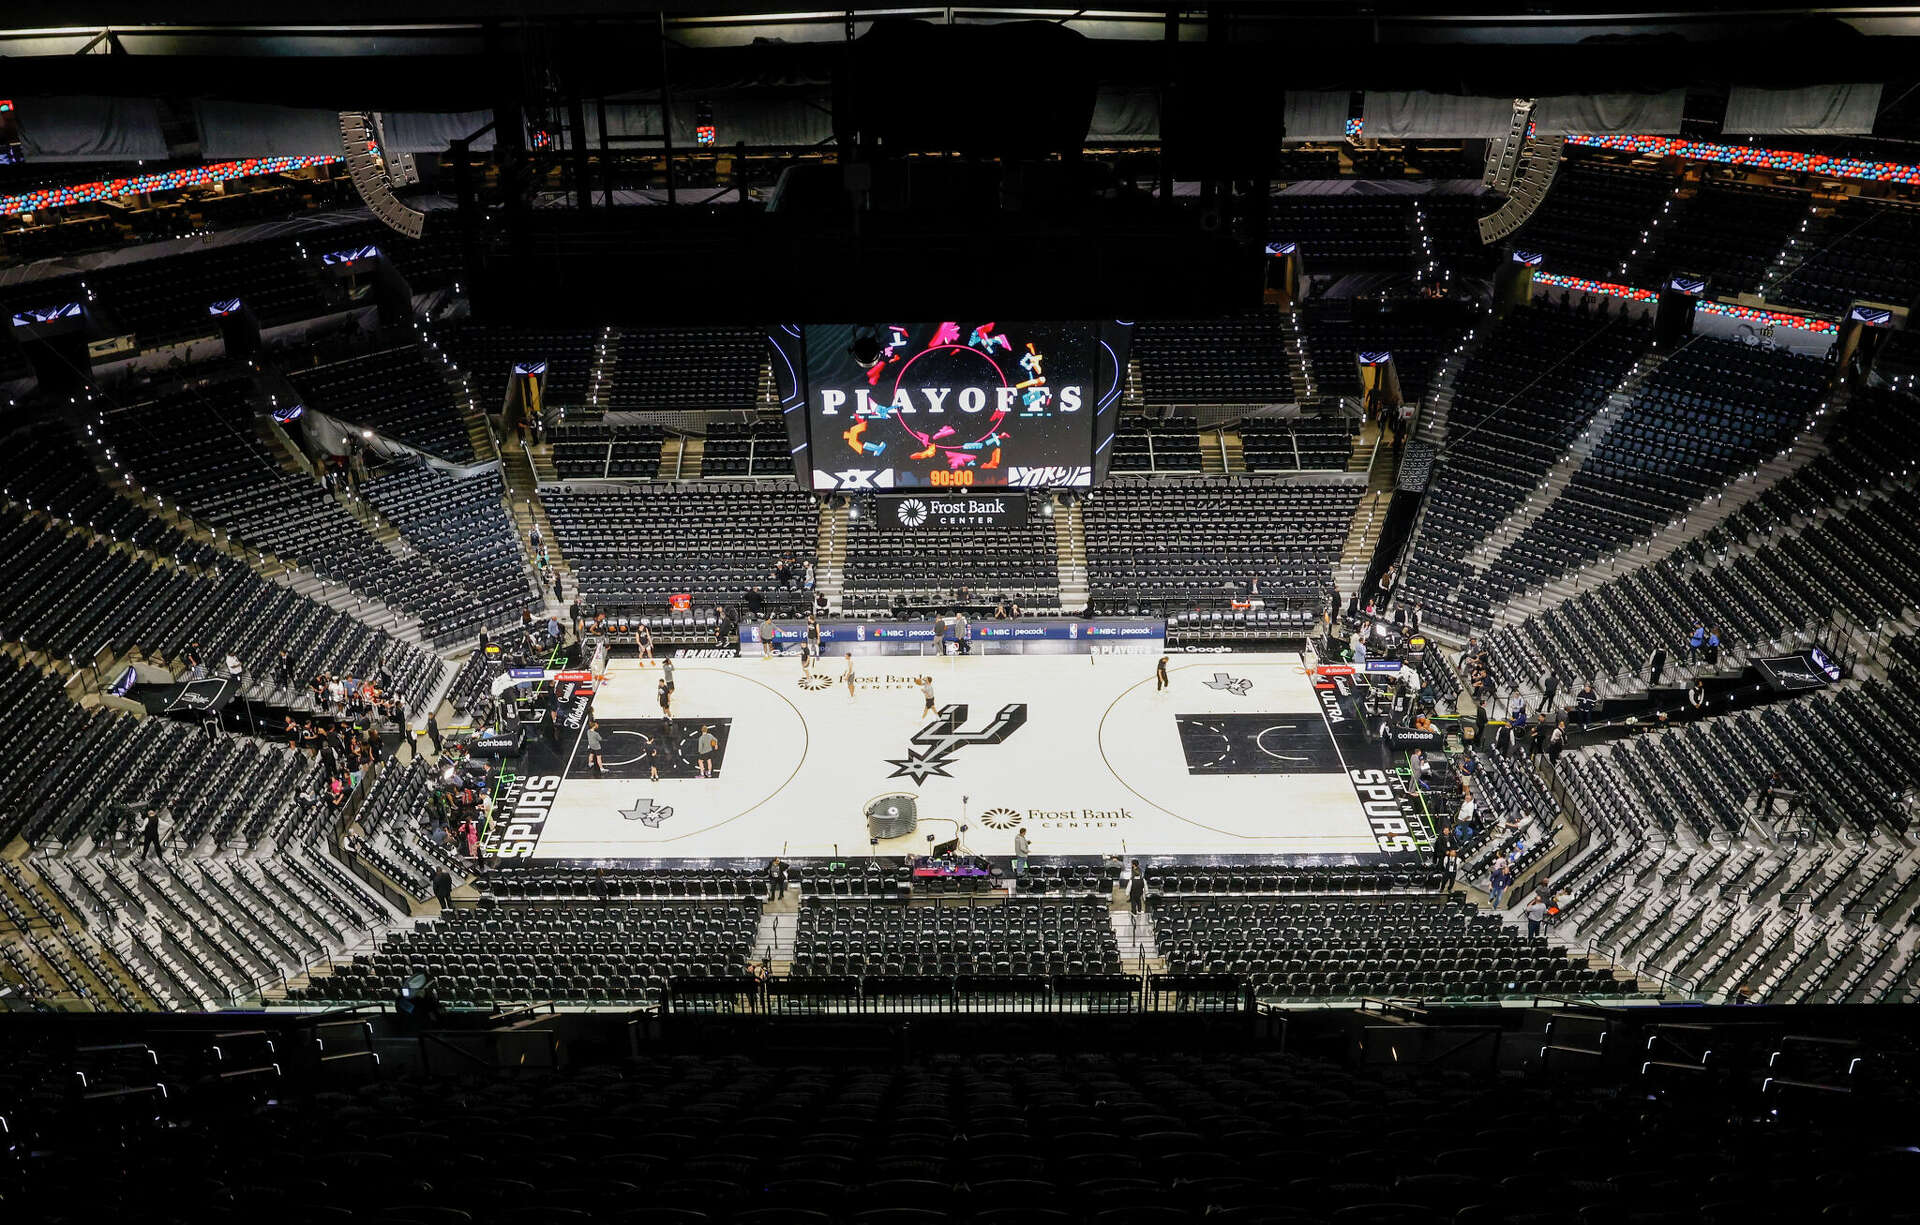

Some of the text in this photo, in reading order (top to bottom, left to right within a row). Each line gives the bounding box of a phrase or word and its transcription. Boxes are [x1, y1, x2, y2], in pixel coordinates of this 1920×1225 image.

[821, 386, 1082, 415] PLAYOFFS
[930, 470, 974, 486] 90:00
[930, 498, 1006, 514] Frost Bank
[1014, 628, 1044, 638] peacock
[1121, 627, 1151, 637] peacock
[685, 649, 736, 658] PLAYOFFS
[1185, 645, 1233, 653] Google
[563, 695, 590, 729] Michelob
[1320, 690, 1345, 723] ULTRA
[477, 739, 513, 748] coinbase
[1397, 731, 1434, 740] coinbase
[1385, 769, 1403, 790] SAN
[497, 775, 562, 858] SPURS
[1028, 808, 1134, 819] Frost Bank
[1350, 769, 1417, 853] SPURS
